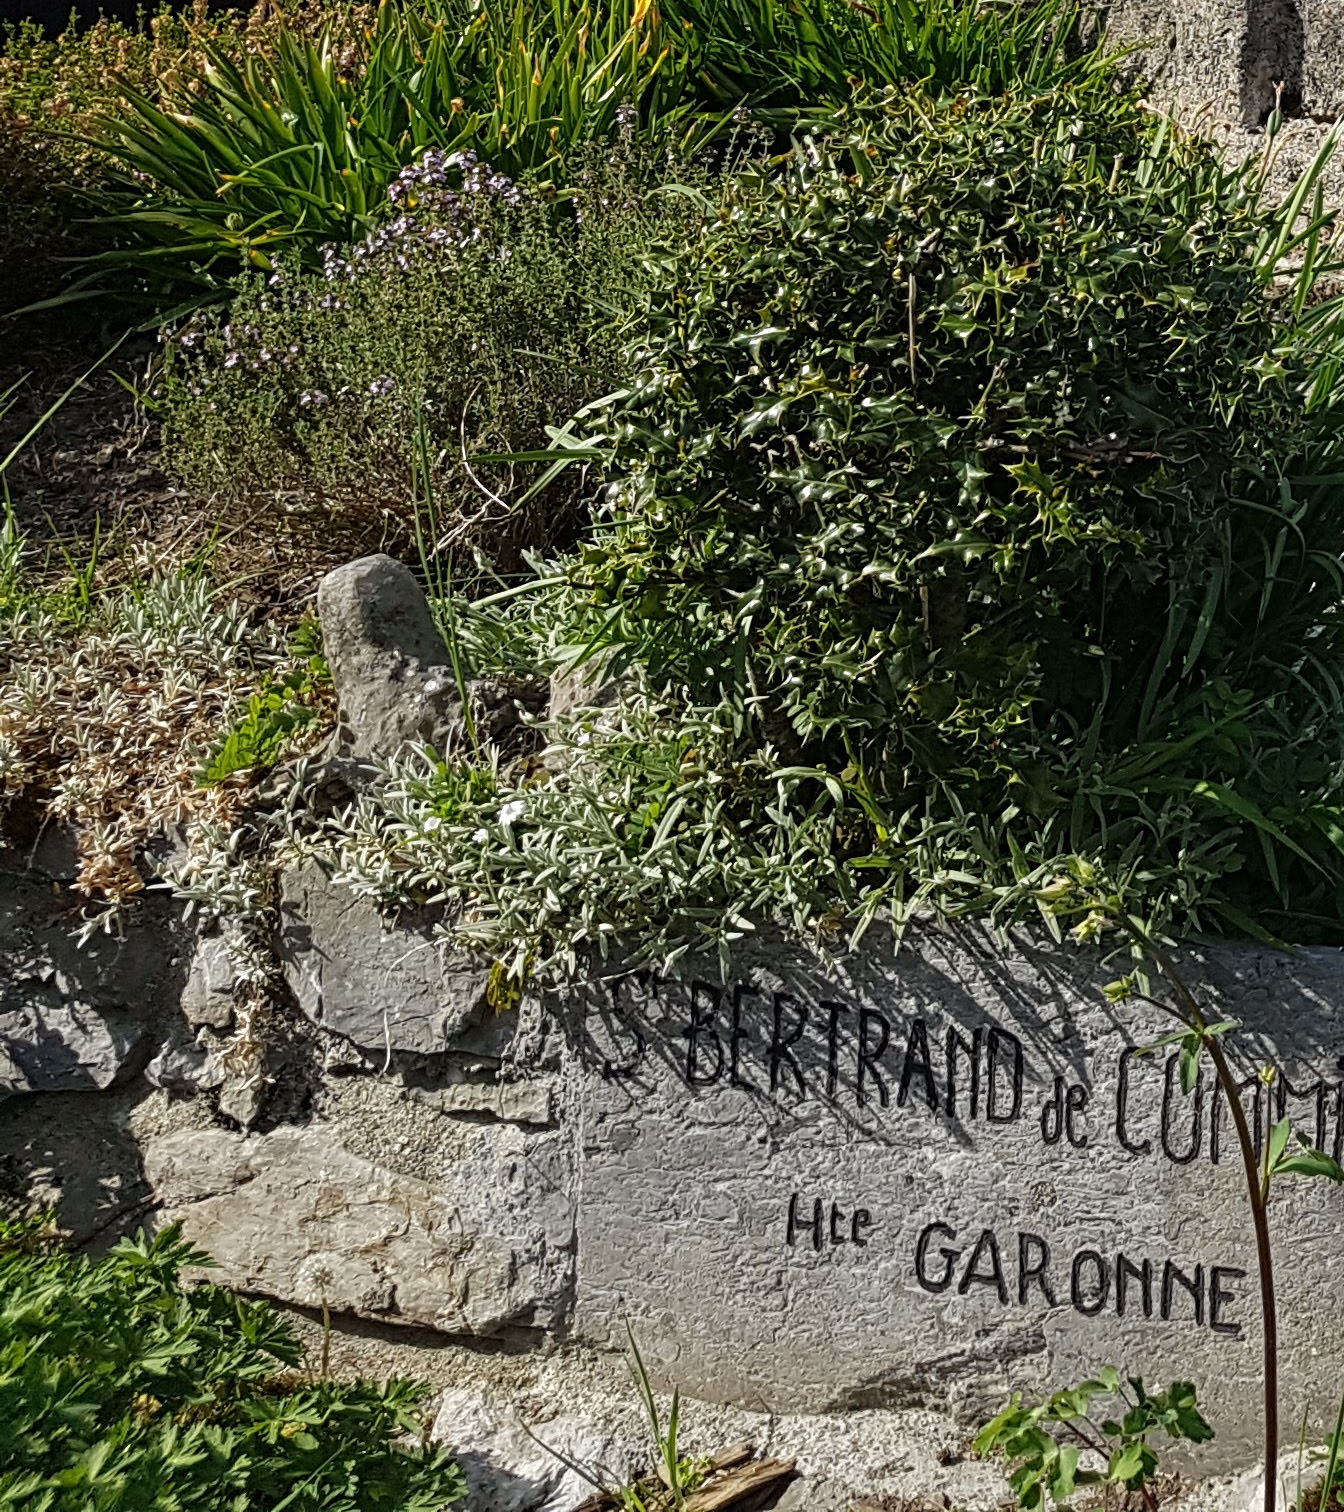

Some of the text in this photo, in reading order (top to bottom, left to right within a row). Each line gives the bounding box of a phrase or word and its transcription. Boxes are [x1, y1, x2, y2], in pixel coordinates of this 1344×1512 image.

[685, 978, 1025, 1125] BERTRAND
[1040, 1074, 1088, 1148] de
[786, 1192, 1246, 1335] Hte GARONNE
